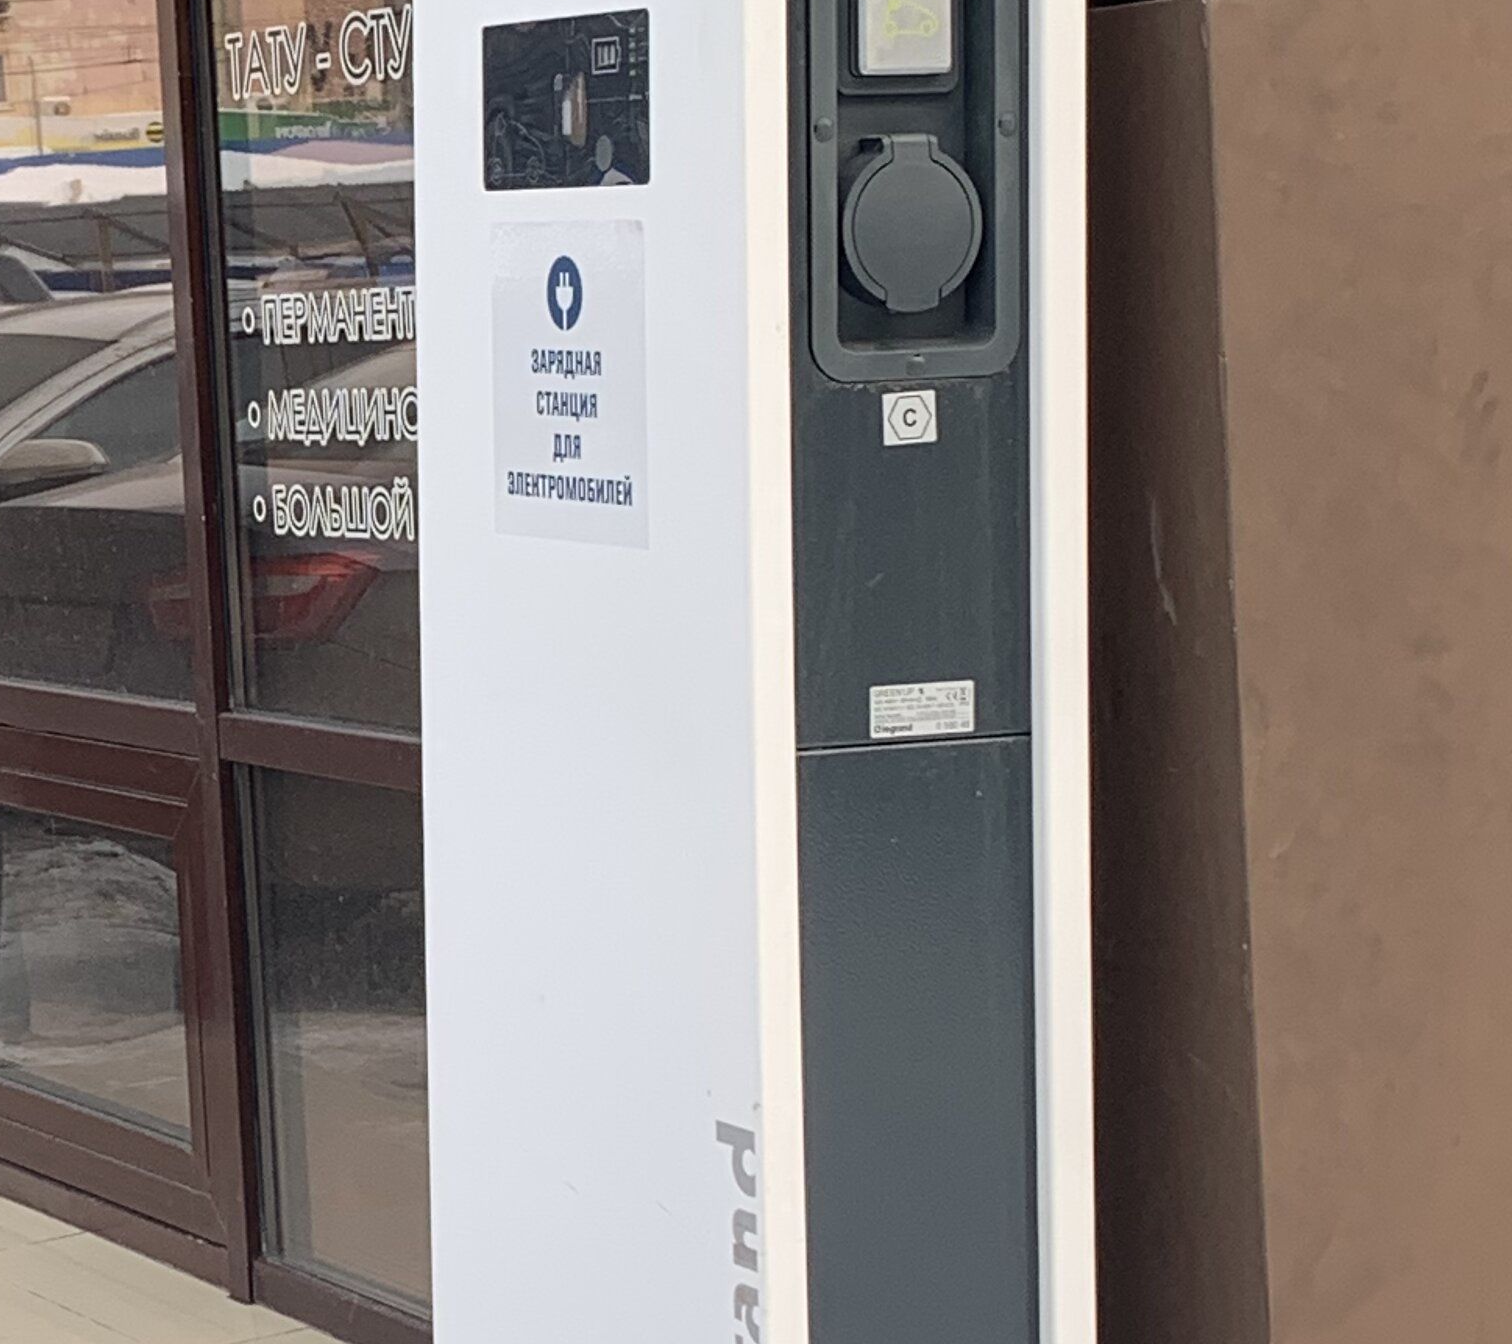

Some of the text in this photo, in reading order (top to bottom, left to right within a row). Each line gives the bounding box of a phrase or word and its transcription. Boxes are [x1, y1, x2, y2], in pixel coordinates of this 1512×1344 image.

[225, 21, 307, 100] ТАТУ
[261, 286, 416, 346] ПЕРМАНЕНТ
[531, 349, 602, 380] ЗАРЯДНАЯ
[536, 390, 598, 422] СТАНЦИЯ
[903, 408, 917, 427] C
[553, 433, 581, 462] ДЛЯ
[507, 471, 633, 506] ЭЛЕКТРОМОБИЛЕЙ
[272, 476, 415, 541] БОЛЬШОЙ
